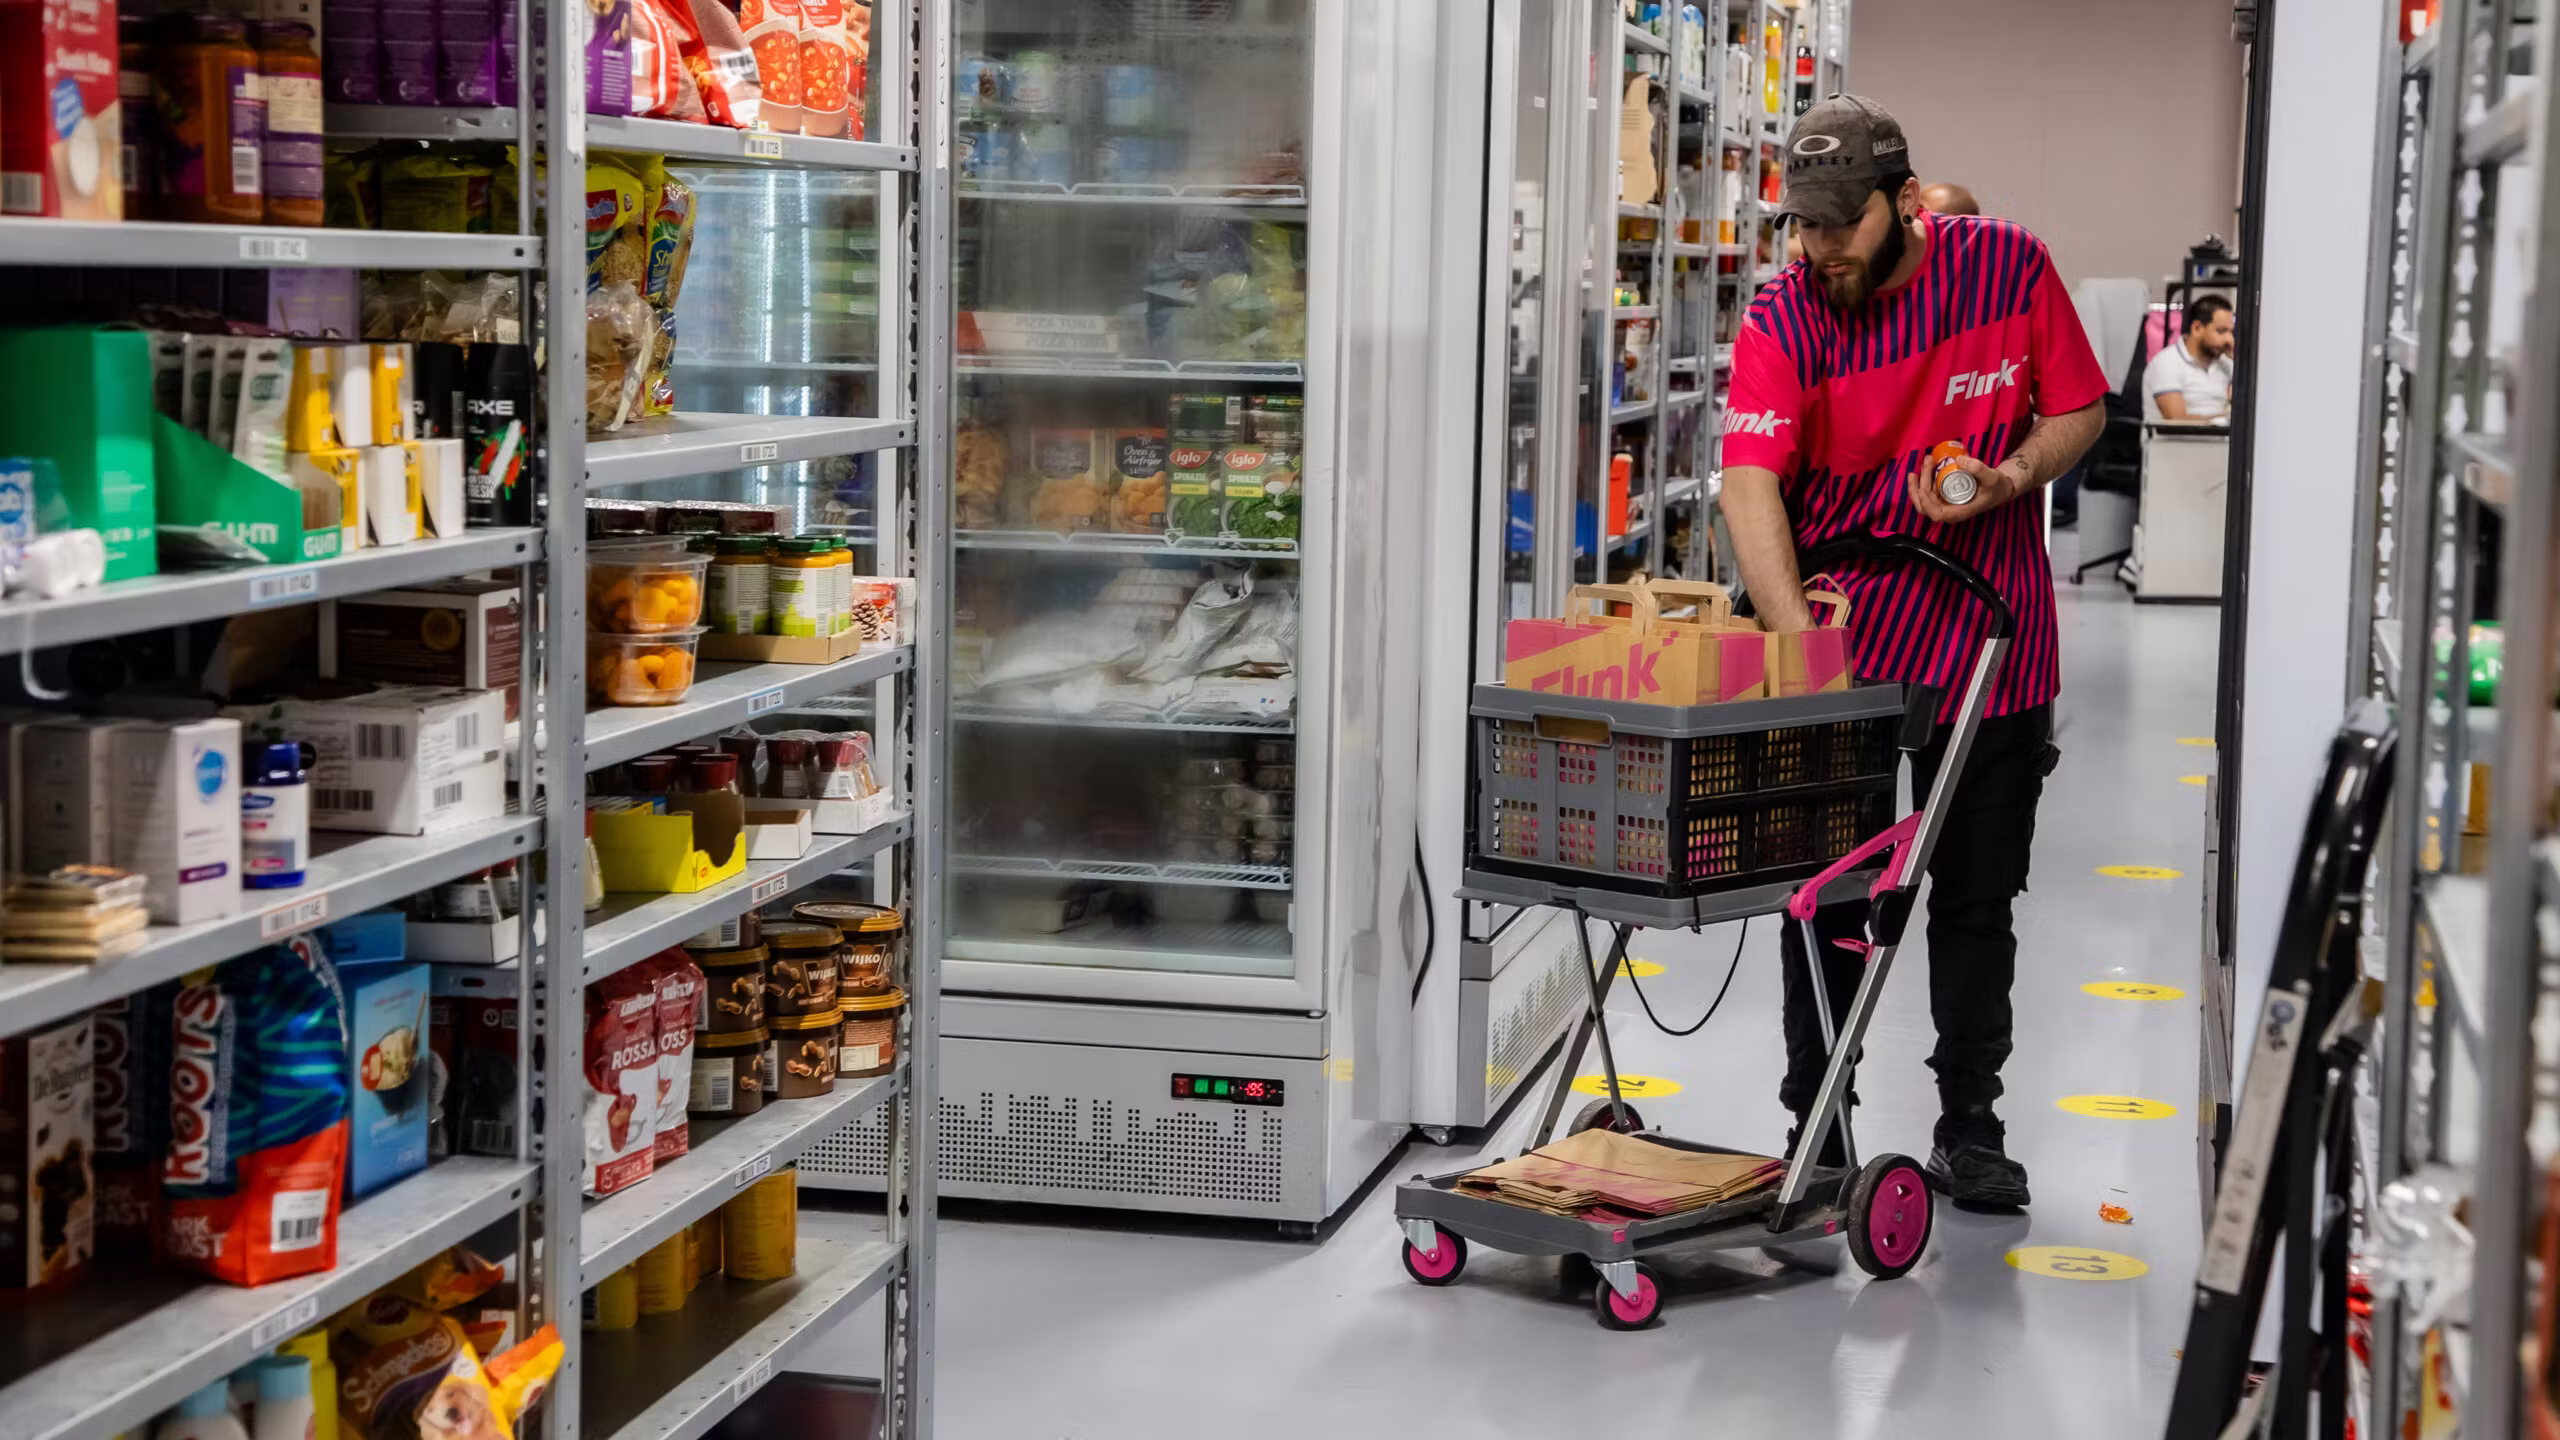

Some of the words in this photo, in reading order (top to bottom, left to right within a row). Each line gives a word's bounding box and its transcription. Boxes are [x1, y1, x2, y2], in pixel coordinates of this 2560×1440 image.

[1944, 358, 2022, 406] Flink
[467, 400, 514, 415] AXE
[1725, 406, 1785, 438] link
[1176, 453, 1201, 464] iglo
[1231, 454, 1256, 467] iglo
[303, 532, 338, 558] GUM
[610, 1040, 656, 1072] ROSSA
[2095, 1101, 2145, 1114] 11
[2051, 1256, 2110, 1274] 13
